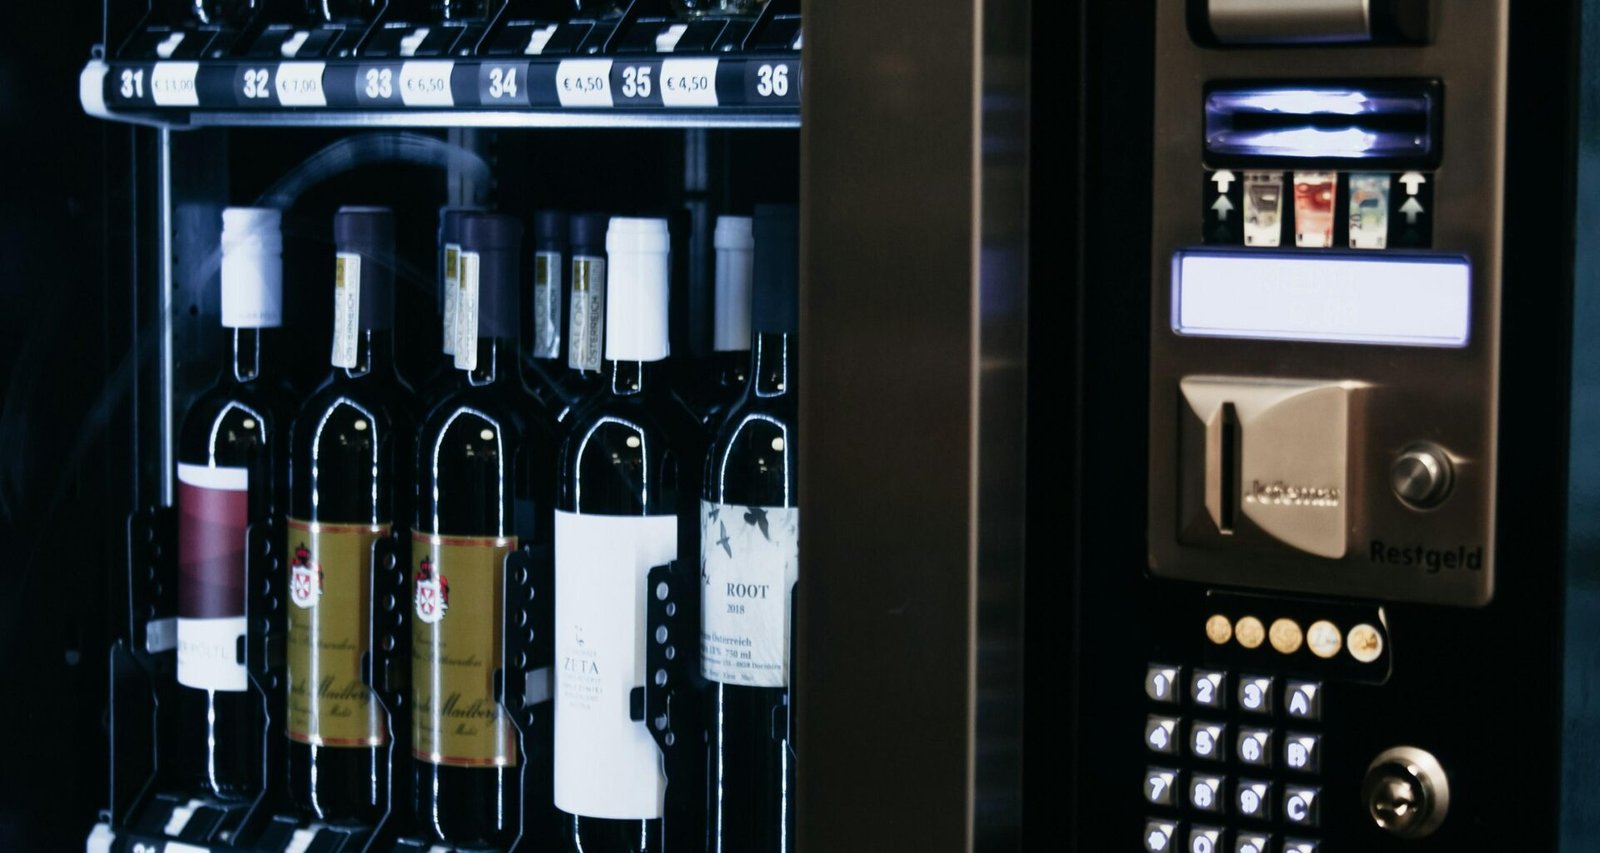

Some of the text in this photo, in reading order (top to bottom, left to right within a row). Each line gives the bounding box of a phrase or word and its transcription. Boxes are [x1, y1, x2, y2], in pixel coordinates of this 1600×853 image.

[121, 69, 144, 98] 31
[243, 69, 270, 98] 32
[365, 68, 392, 98] 33
[407, 79, 444, 93] € 6,50
[489, 67, 517, 98] 34
[563, 77, 603, 92] € 4,50
[622, 66, 651, 98] 35
[667, 76, 708, 92] € 4,50
[757, 64, 789, 97] 36
[1369, 540, 1482, 573] Restgeld
[726, 582, 769, 599] ROOT
[726, 603, 745, 615] 2018
[1153, 674, 1307, 715] 1 2 3 A
[1149, 726, 1306, 767] 4 5 6 B
[1149, 777, 1306, 821] 7 8 9 C
